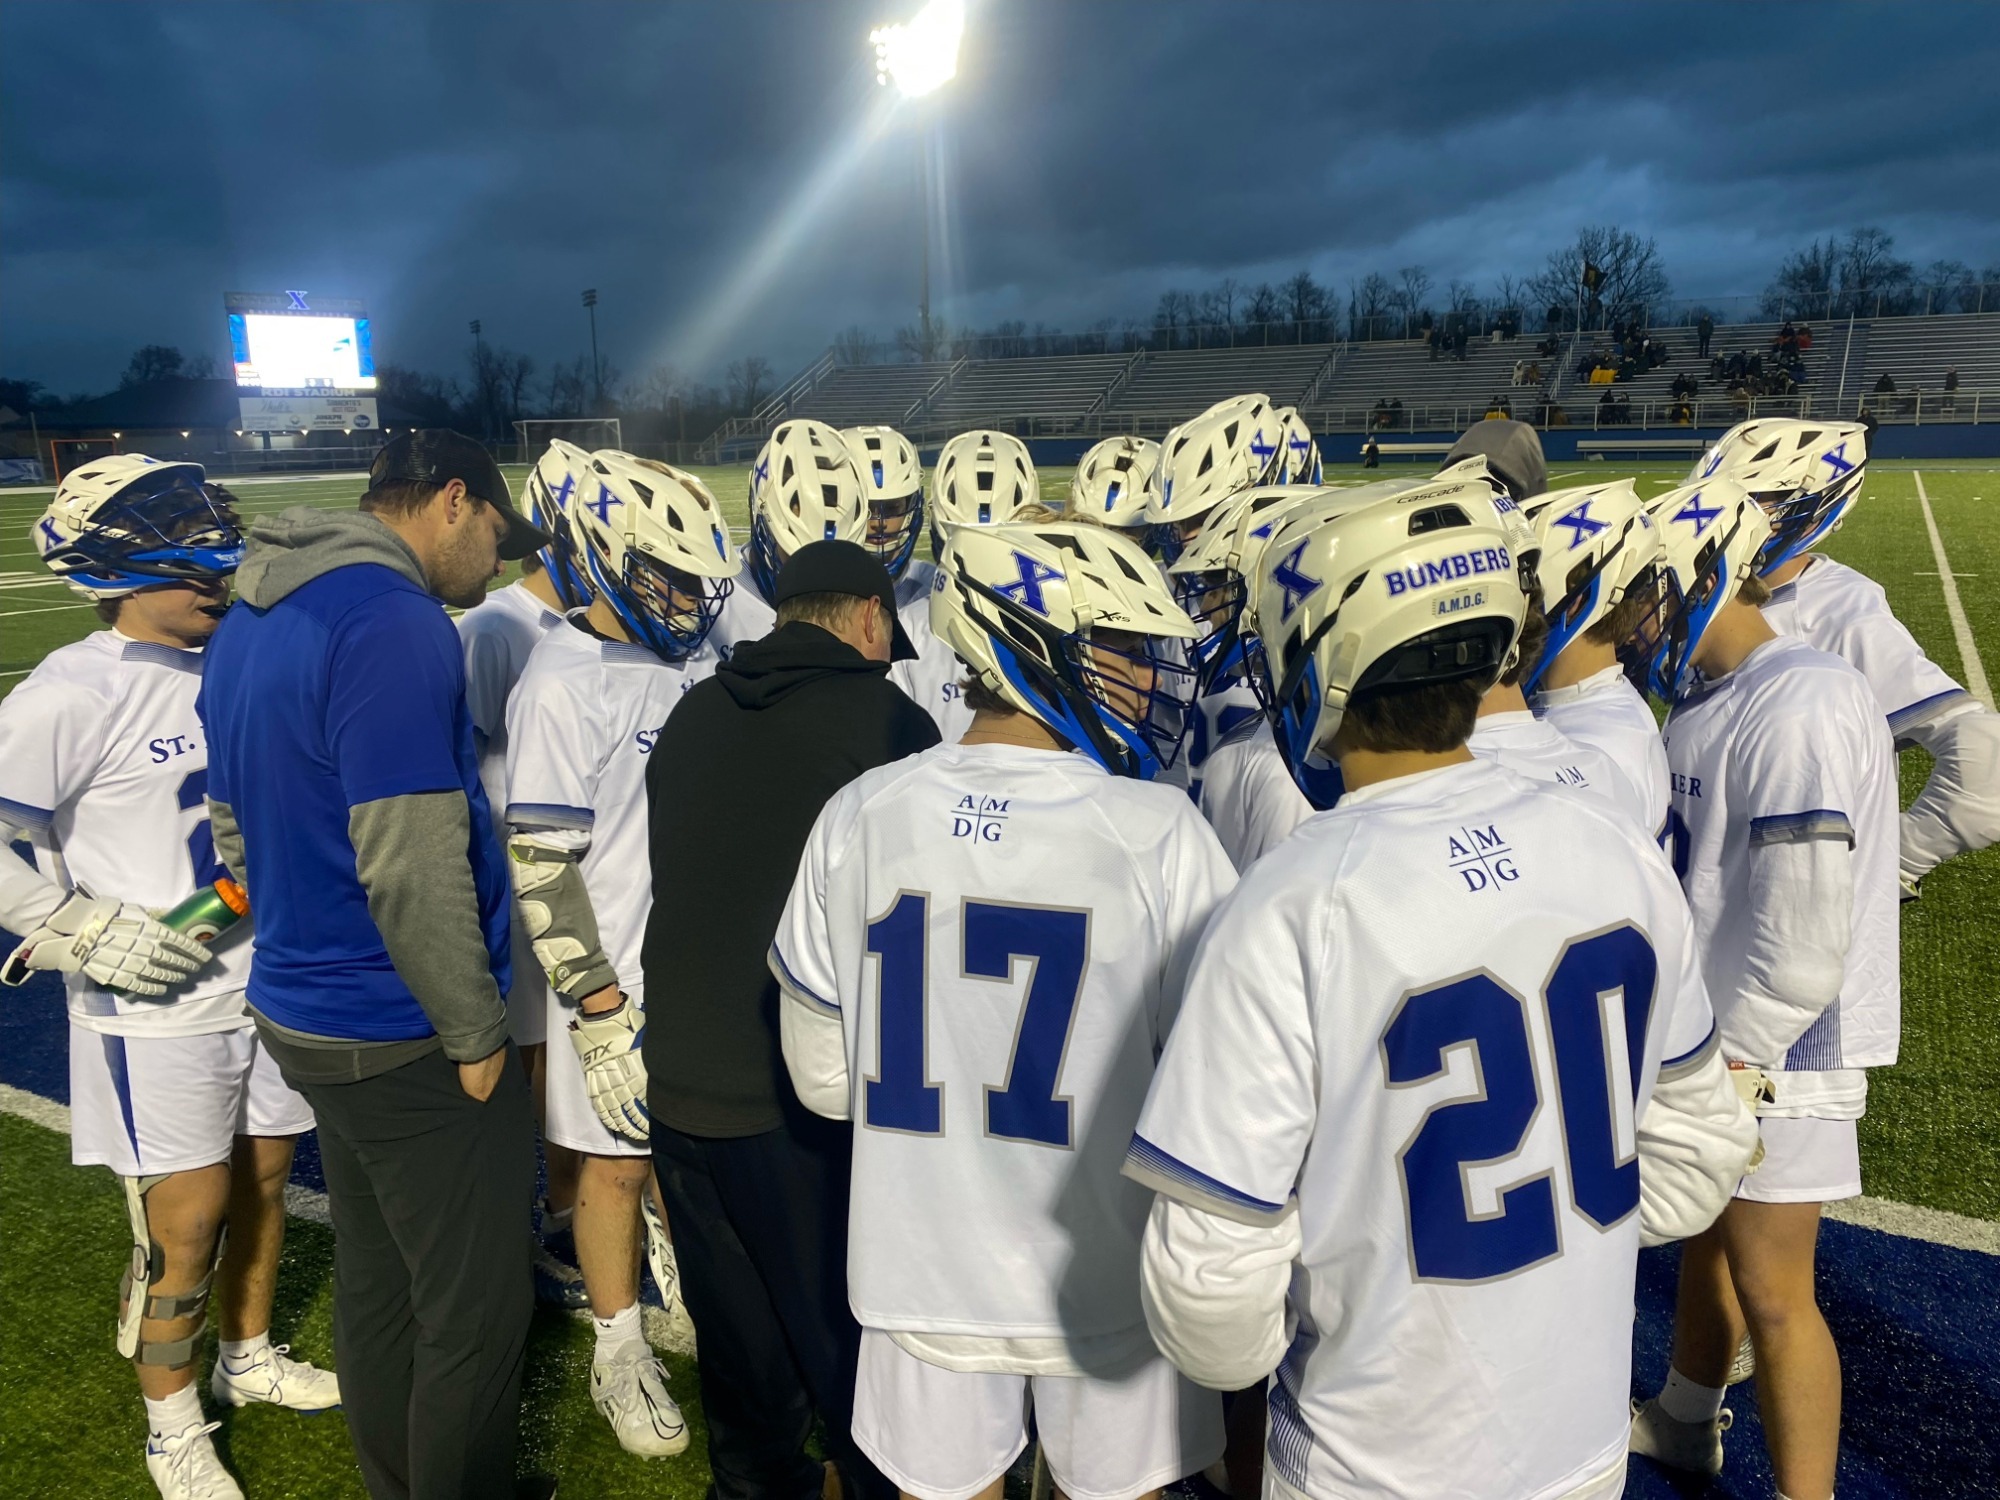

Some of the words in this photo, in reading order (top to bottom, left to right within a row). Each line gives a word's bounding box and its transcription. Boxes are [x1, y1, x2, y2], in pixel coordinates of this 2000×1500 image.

[285, 290, 310, 310] X
[261, 388, 290, 397] RDI
[294, 388, 356, 397] STADIUM
[1457, 460, 1485, 472] cascad
[1819, 441, 1856, 484] X
[584, 481, 626, 528] X
[1396, 484, 1466, 504] cascade
[1551, 499, 1613, 551] X
[1670, 492, 1727, 539] X
[39, 516, 67, 552] X
[989, 549, 1067, 618] X
[1271, 536, 1324, 625] X
[1093, 608, 1131, 623] XRS
[1437, 592, 1486, 615] A.M.D.G.
[149, 735, 196, 764] ST.
[863, 887, 1094, 1152] 17
[582, 1040, 614, 1066] STX
[1377, 917, 1660, 1288] 20
